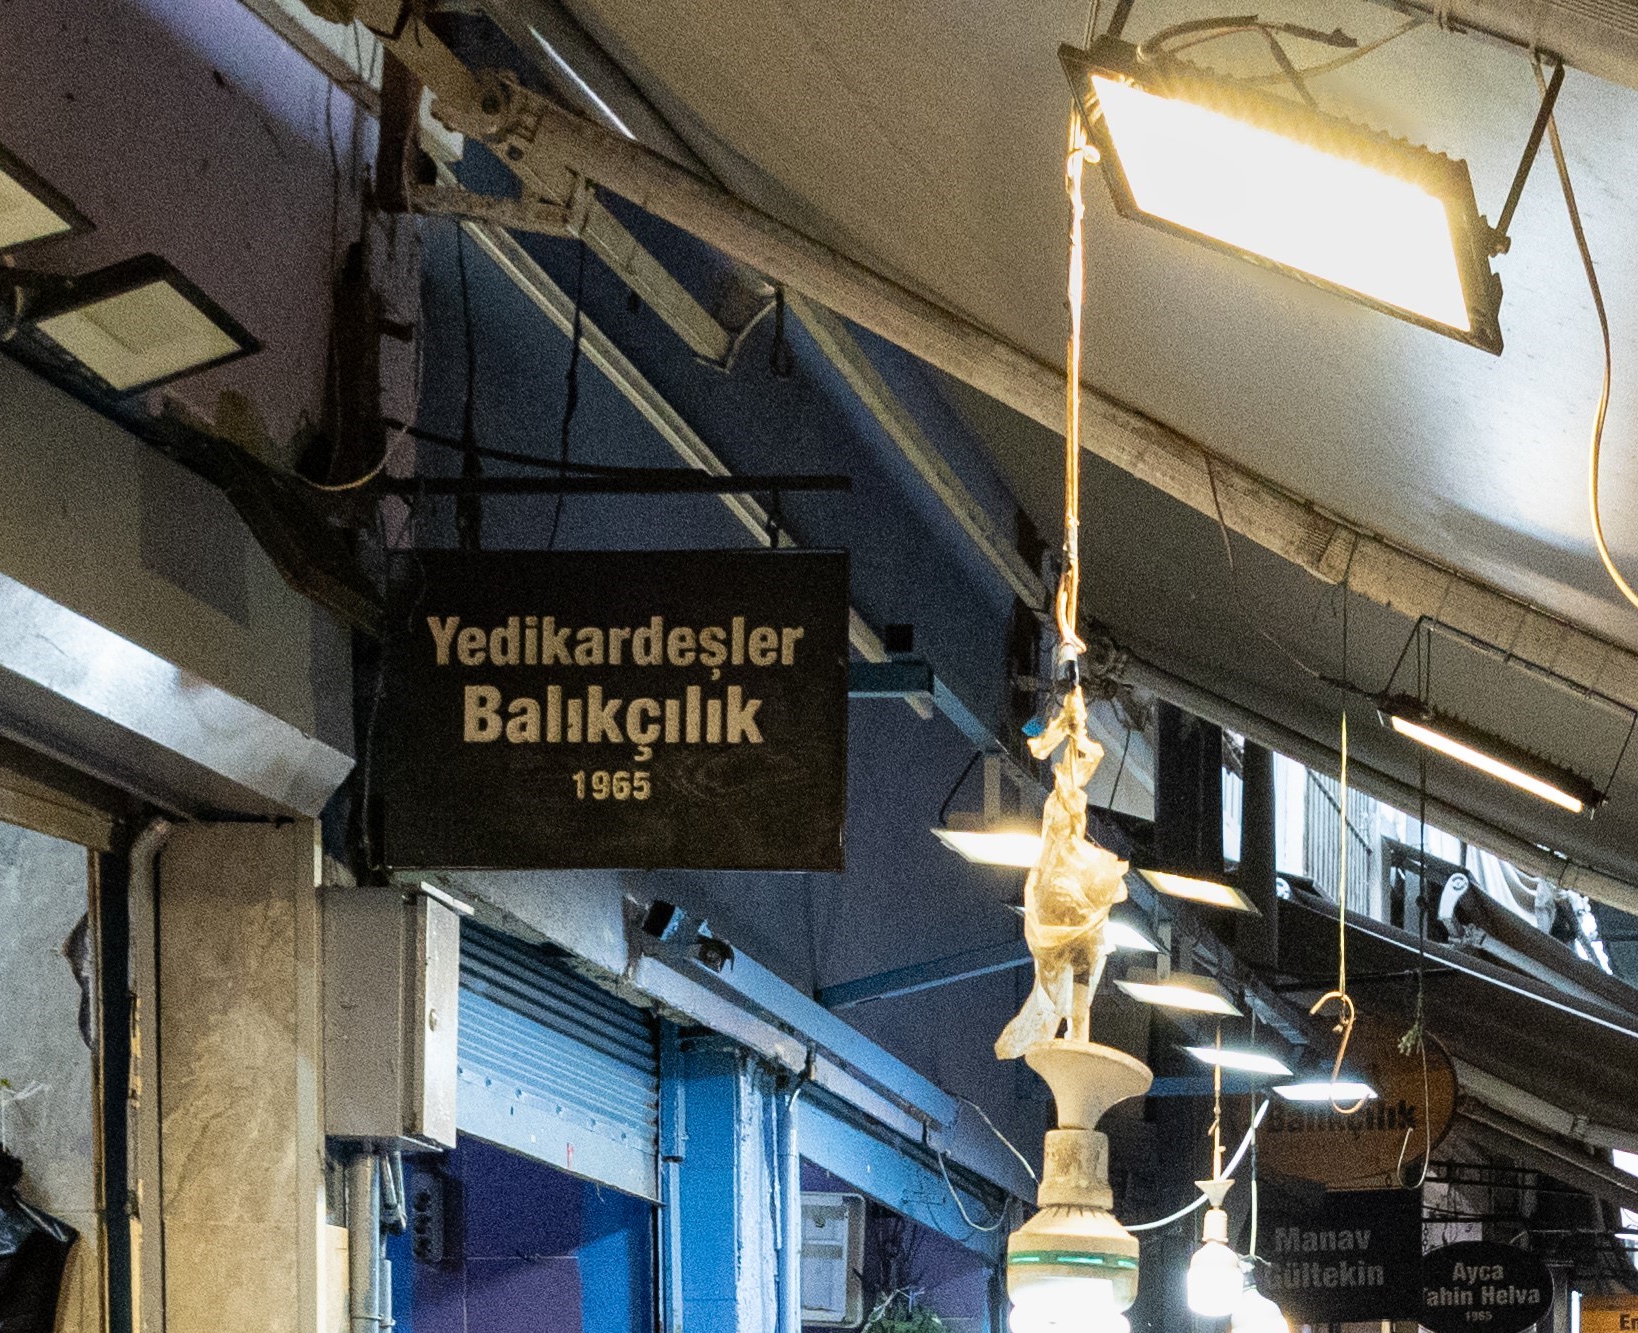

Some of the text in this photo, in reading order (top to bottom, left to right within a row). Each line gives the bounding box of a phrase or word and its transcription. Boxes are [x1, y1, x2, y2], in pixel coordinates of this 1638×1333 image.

[427, 615, 804, 681] Yedikardeşler
[462, 684, 764, 762] Balıkçılık
[572, 770, 651, 800] 1965
[1275, 1226, 1371, 1252] Manav
[1480, 1284, 1541, 1306] Helva
